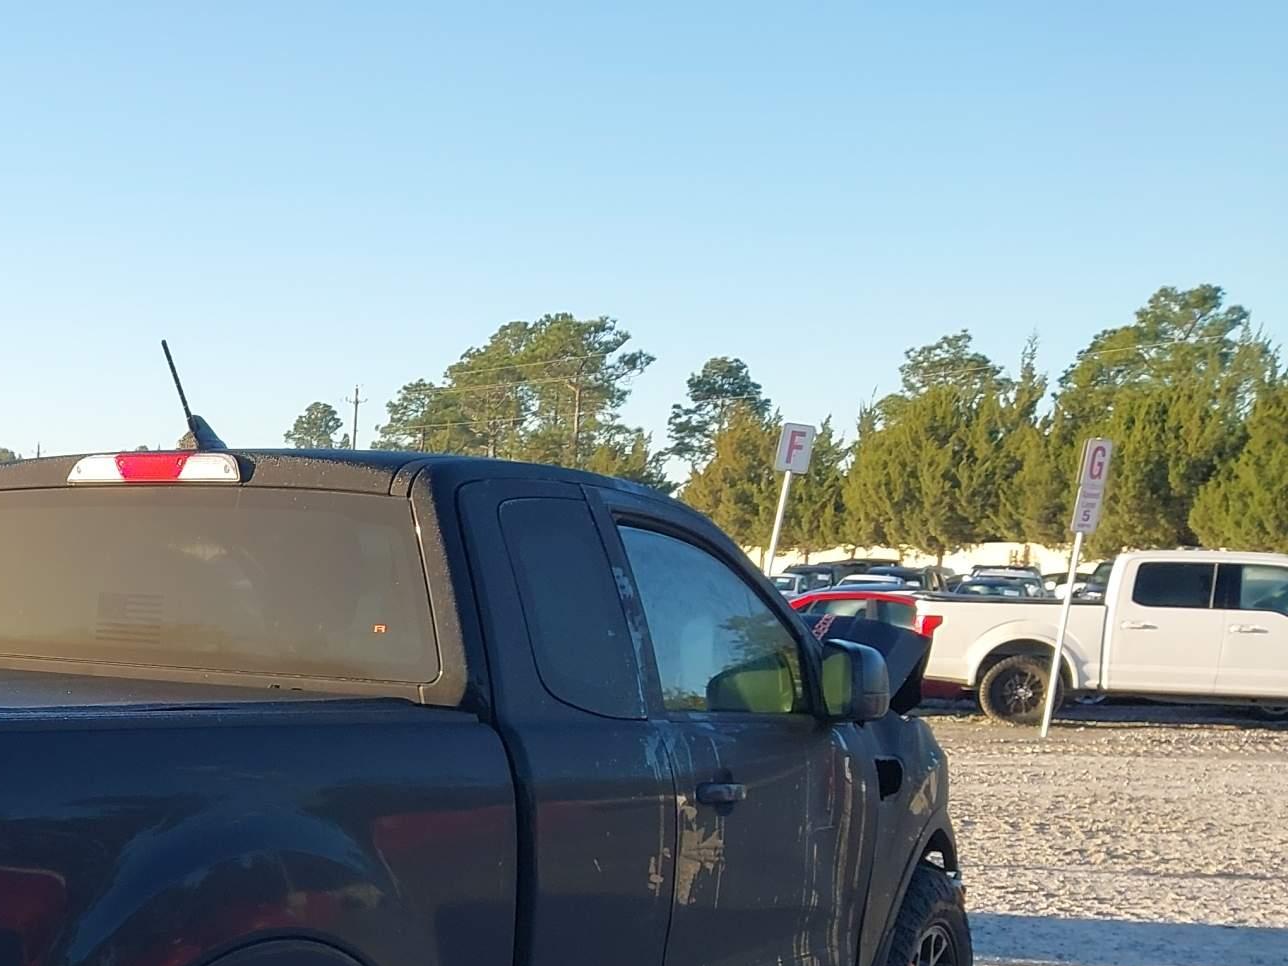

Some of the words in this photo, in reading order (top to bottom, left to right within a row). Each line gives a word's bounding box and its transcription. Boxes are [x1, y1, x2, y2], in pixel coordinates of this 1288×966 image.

[785, 430, 807, 464] F
[1089, 445, 1106, 480] G
[1081, 509, 1090, 522] 5
